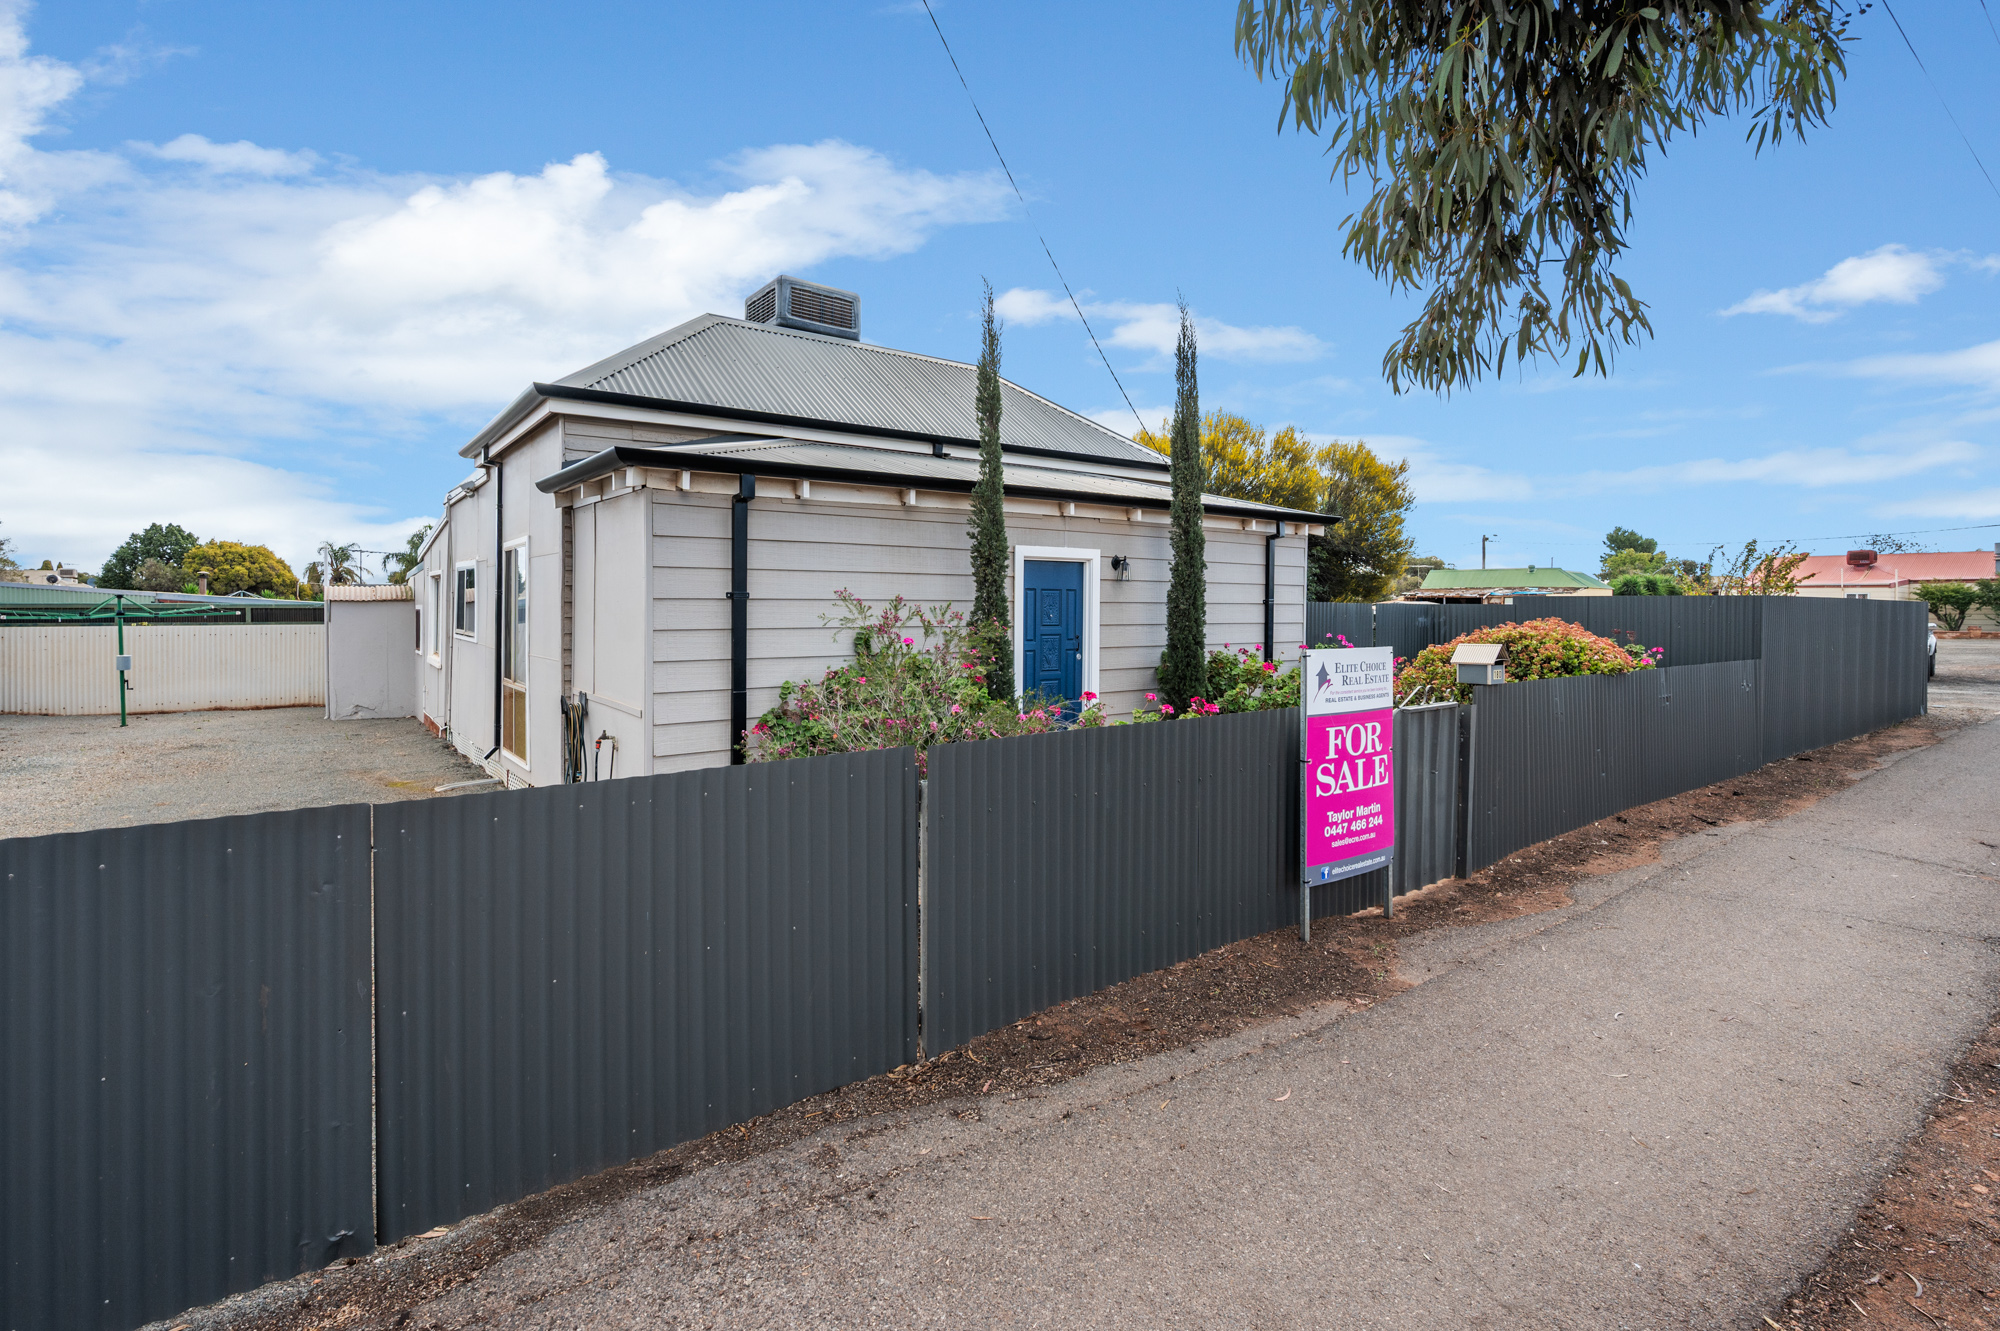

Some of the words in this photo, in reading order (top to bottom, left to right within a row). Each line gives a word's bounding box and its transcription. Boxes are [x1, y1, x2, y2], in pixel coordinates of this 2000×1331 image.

[1335, 662, 1358, 673] ELITE
[1360, 661, 1386, 672] CHOICE
[1342, 675, 1363, 686] REAL
[1364, 674, 1389, 685] ESTATE
[1326, 722, 1382, 759] FOR
[1316, 754, 1388, 797] SALE
[1327, 809, 1354, 823] Taylor
[1356, 802, 1380, 817] Martin
[1324, 823, 1348, 837] 0447
[1350, 818, 1366, 831] 466
[1369, 814, 1383, 828] 244
